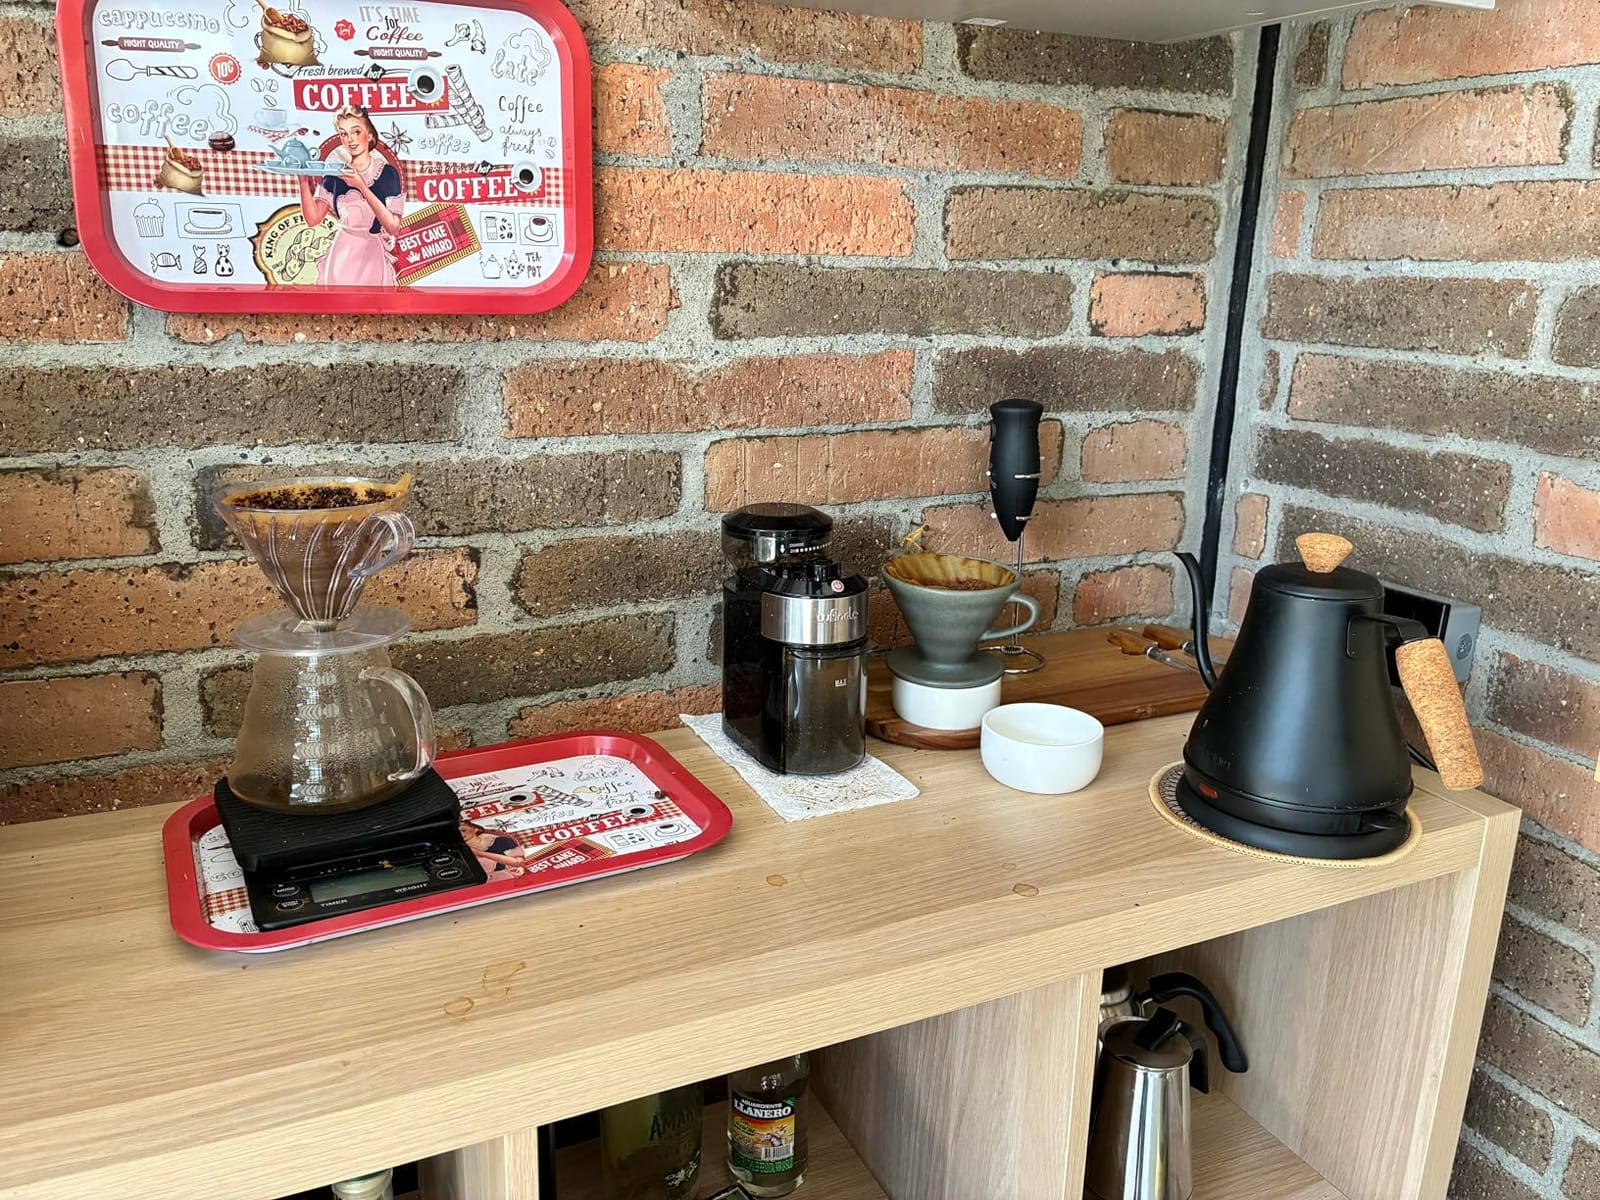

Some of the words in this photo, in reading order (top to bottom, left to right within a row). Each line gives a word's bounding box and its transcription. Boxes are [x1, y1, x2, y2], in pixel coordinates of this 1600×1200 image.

[99, 9, 220, 33] cappuccino
[359, 6, 384, 22] IT'S
[388, 7, 420, 23] TIME
[385, 15, 399, 30] for
[148, 40, 180, 49] QUALITY
[366, 25, 423, 44] Coffee
[395, 49, 423, 58] QUALITY
[297, 65, 325, 77] Fresh
[328, 64, 365, 76] brewed
[302, 82, 417, 110] COFFEE
[499, 95, 544, 123] Coffee
[105, 99, 208, 141] coffee
[418, 133, 471, 155] coffee
[499, 126, 542, 143] always
[502, 137, 535, 157] fresh
[423, 176, 518, 201] COFFEE
[265, 230, 279, 258] KING
[277, 218, 291, 231] OF
[398, 234, 421, 252] BEST
[423, 225, 447, 241] CAKE
[421, 239, 453, 259] AWARD
[589, 781, 633, 794] Coffee
[539, 814, 636, 843] COFFEE
[528, 860, 552, 873] BEST
[551, 850, 576, 863] CAKE
[553, 856, 586, 870] AWARD
[394, 882, 428, 893] WEIGHT
[320, 898, 348, 908] TIMER
[734, 1098, 793, 1119] LLANERO
